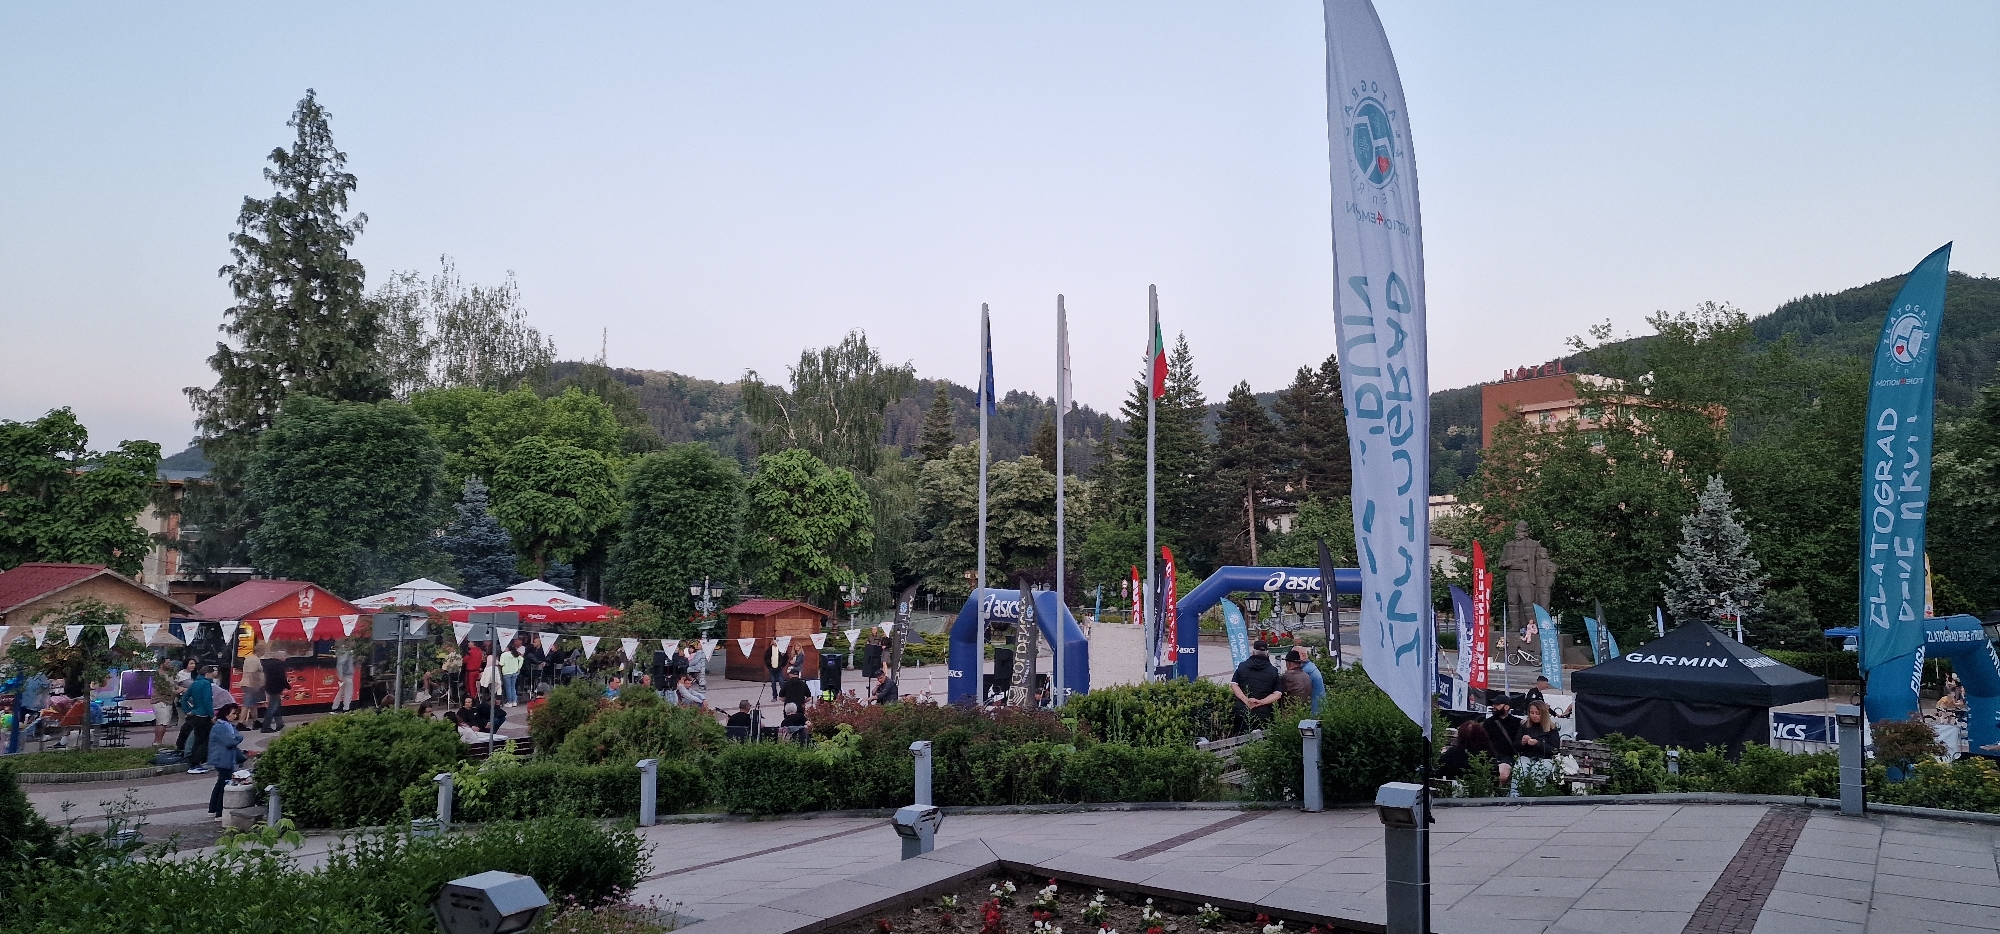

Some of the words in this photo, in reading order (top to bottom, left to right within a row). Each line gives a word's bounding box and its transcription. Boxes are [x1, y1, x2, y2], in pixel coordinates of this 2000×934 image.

[1503, 361, 1567, 381] HOTEL
[1285, 576, 1321, 590] asic
[1625, 652, 1729, 668] GARMIN
